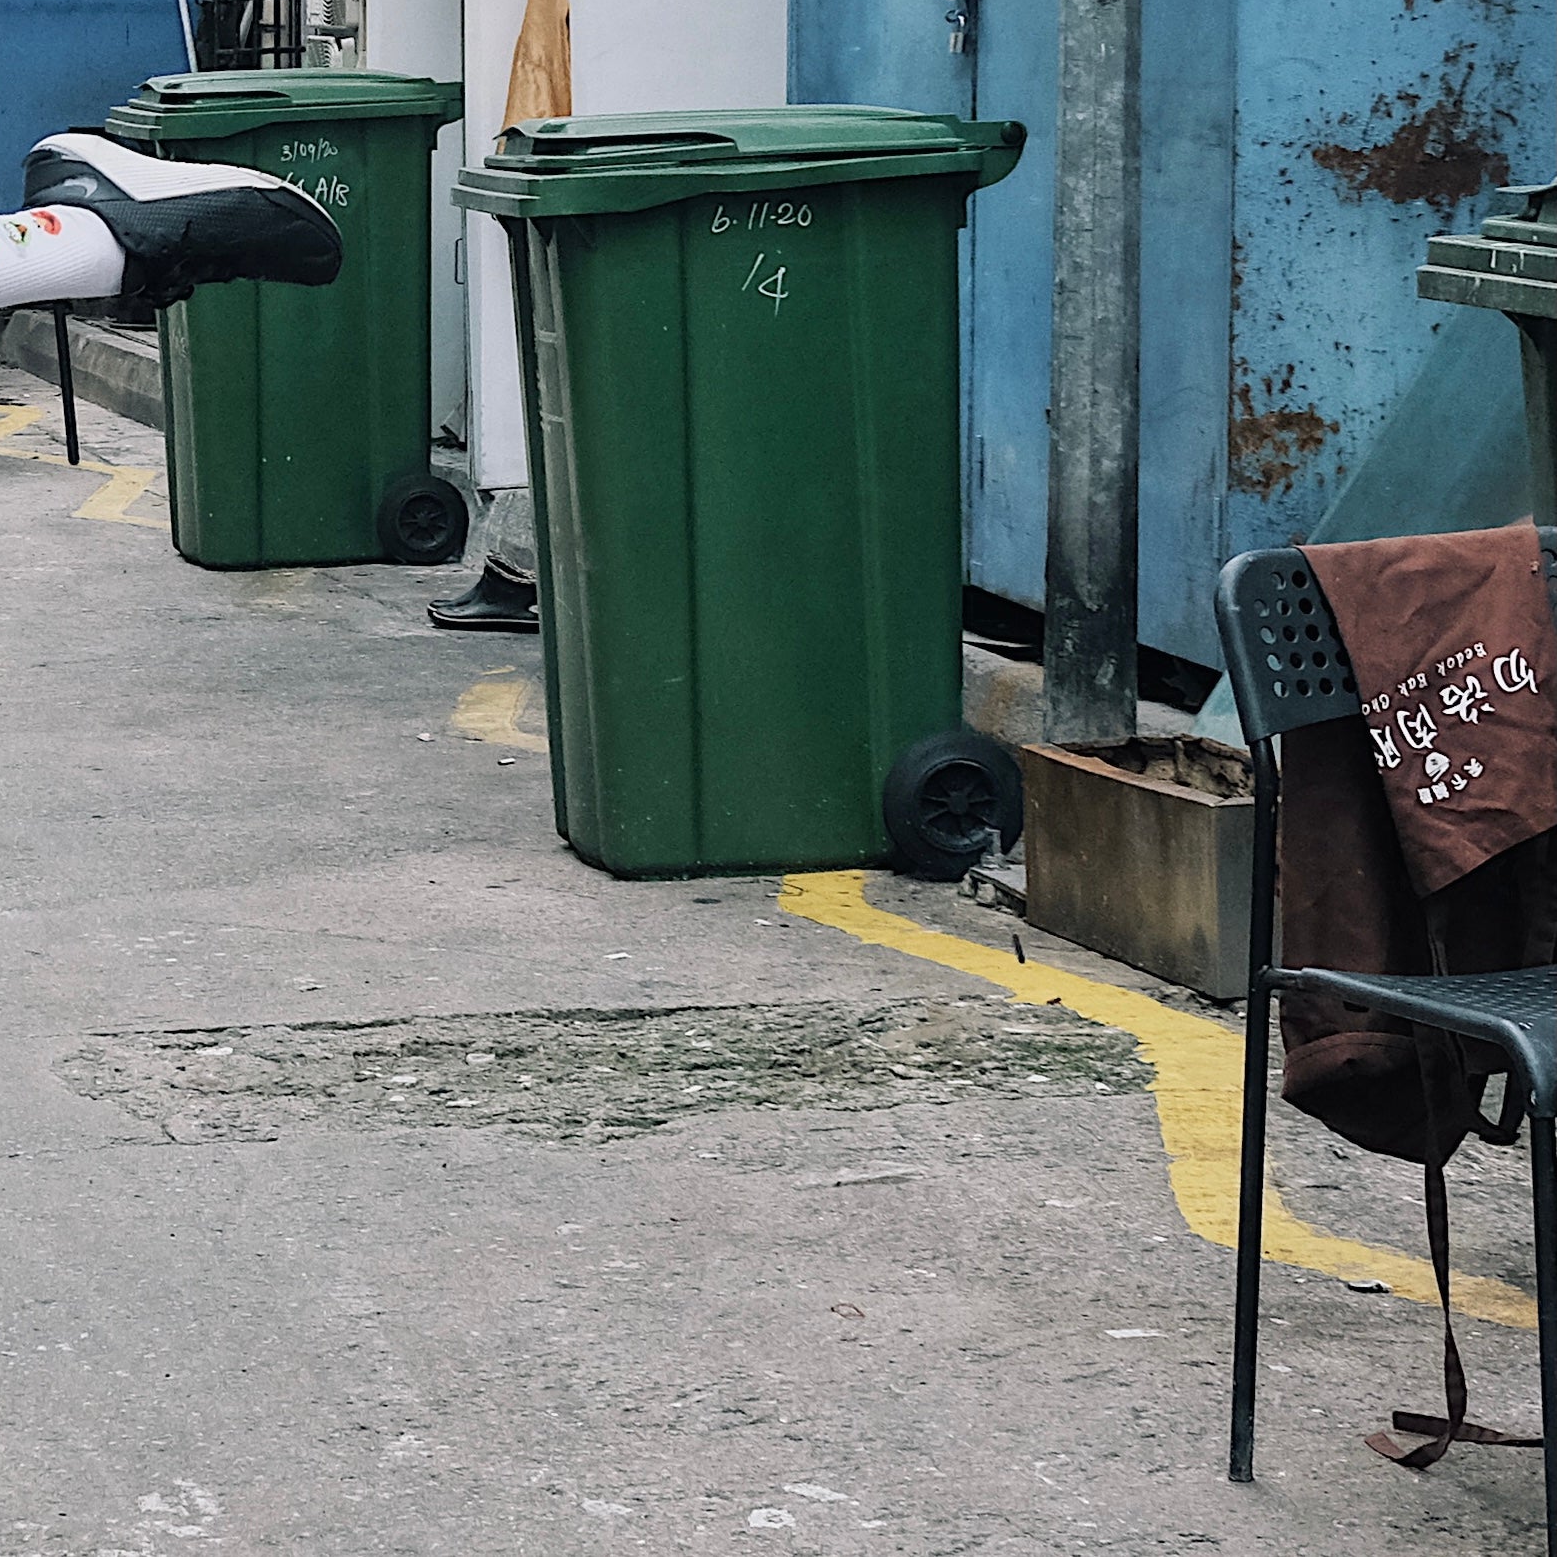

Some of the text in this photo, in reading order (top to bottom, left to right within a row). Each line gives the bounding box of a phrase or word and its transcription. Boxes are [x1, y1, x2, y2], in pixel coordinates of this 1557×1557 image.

[280, 137, 339, 164] 3/09/20
[314, 175, 350, 207] A/B
[1361, 641, 1488, 716] Bedok Bak Cho
